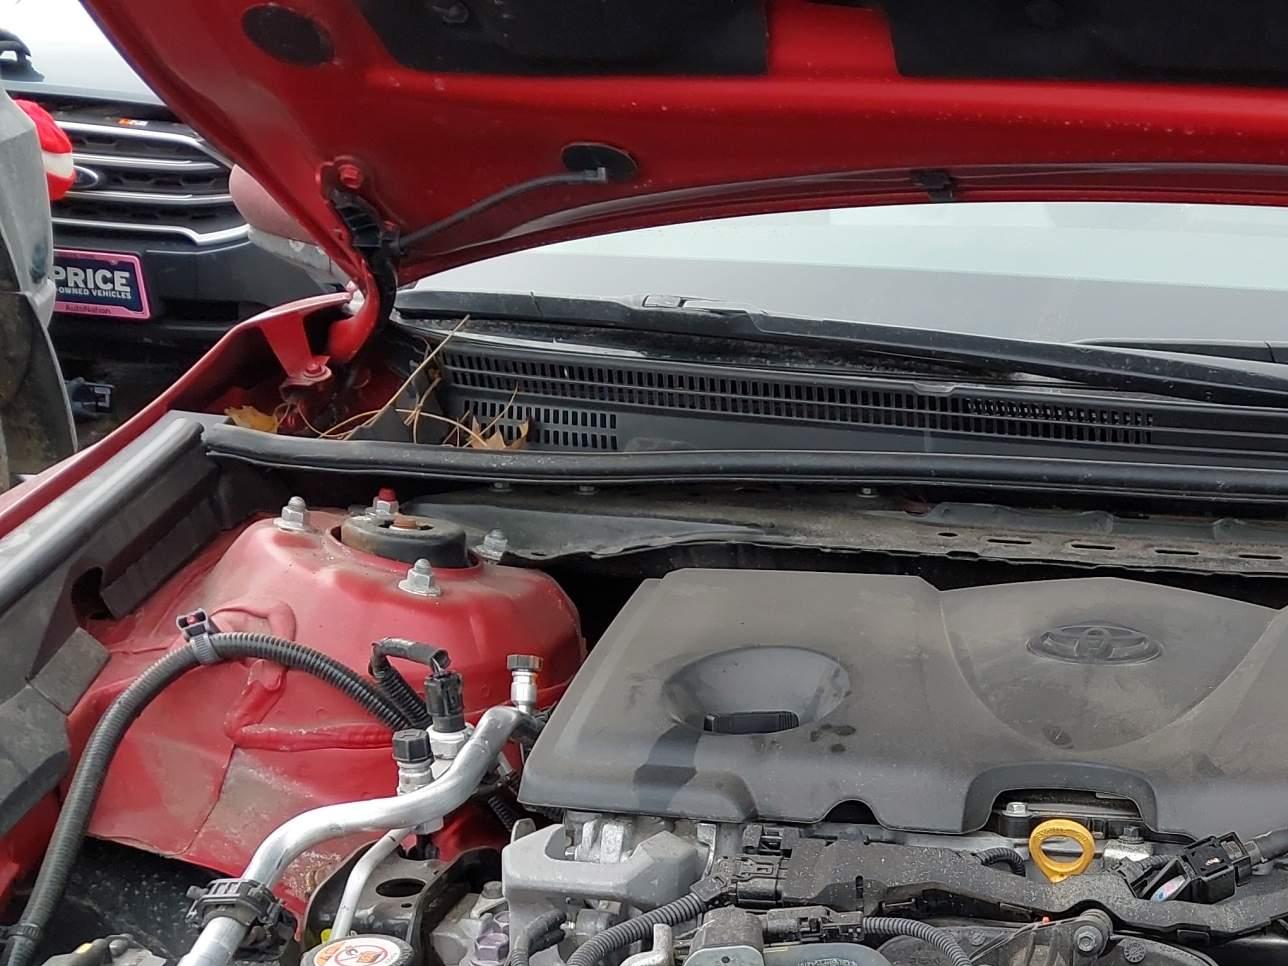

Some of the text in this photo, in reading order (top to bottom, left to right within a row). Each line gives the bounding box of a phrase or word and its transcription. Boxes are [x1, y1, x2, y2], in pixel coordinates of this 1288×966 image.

[53, 265, 131, 292] PRICE
[59, 286, 132, 299] OWNED VEHICLES
